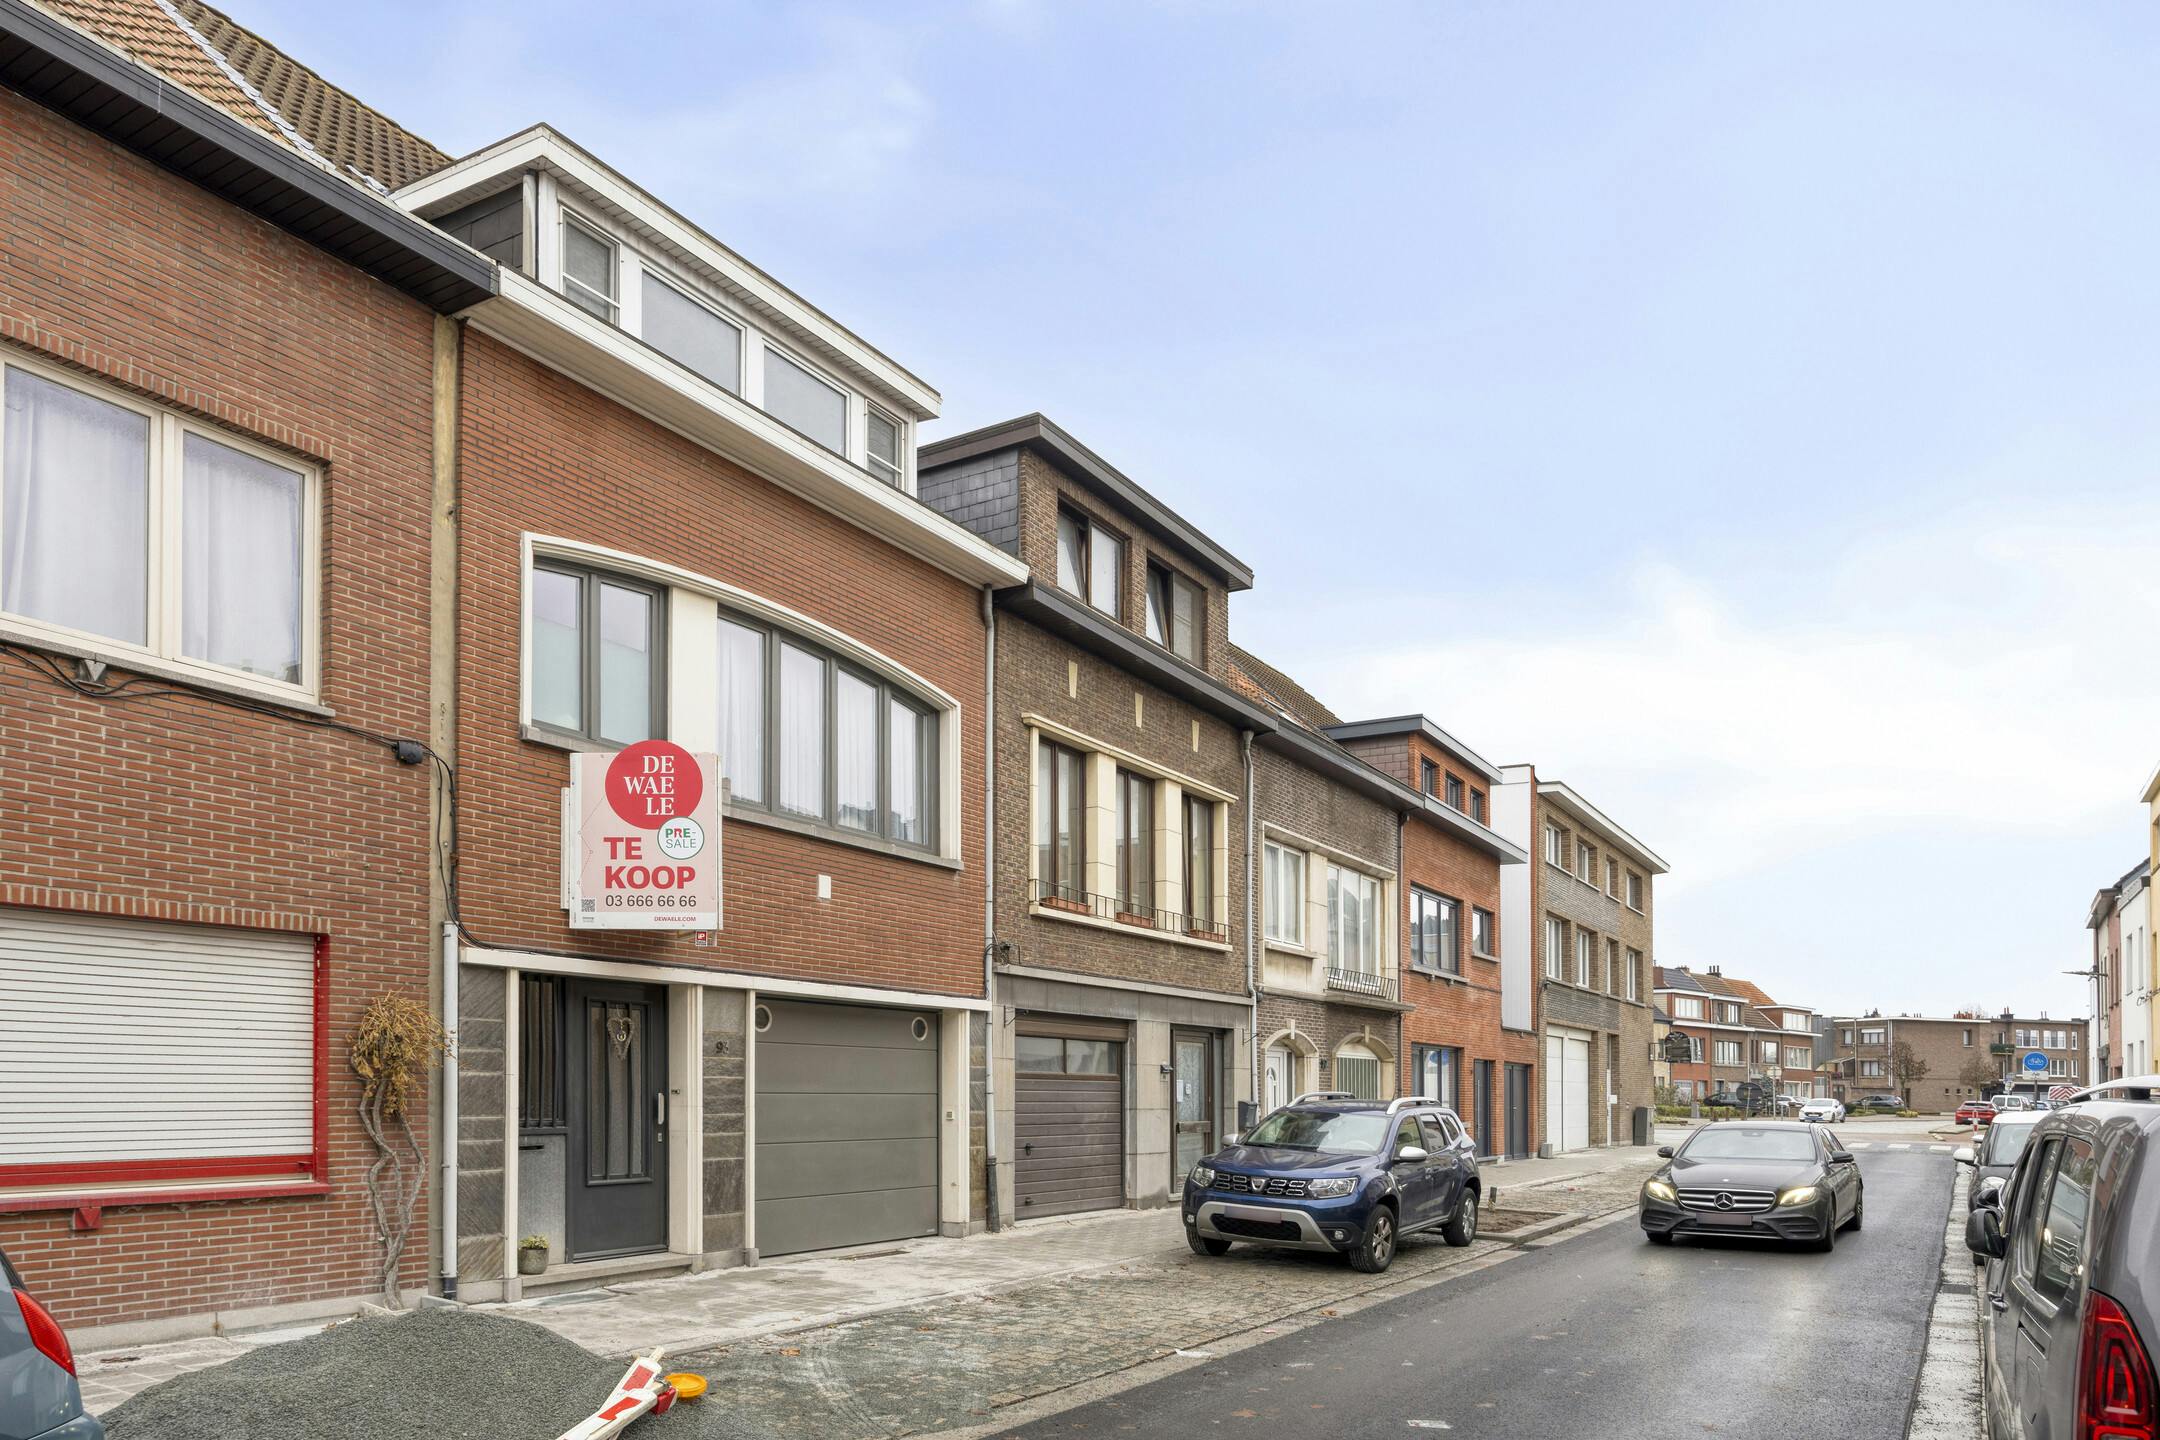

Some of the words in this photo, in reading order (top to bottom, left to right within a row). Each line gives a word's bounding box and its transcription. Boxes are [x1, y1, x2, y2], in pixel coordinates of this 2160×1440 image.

[643, 755, 675, 774] DE
[624, 776, 675, 795] WAE
[646, 797, 675, 816] LE
[603, 837, 642, 860] TE
[665, 839, 697, 849] SALE
[605, 866, 696, 889] KOOP
[605, 895, 623, 907] 03
[627, 895, 653, 907] 666
[657, 895, 675, 907] 66
[679, 895, 697, 907] 66
